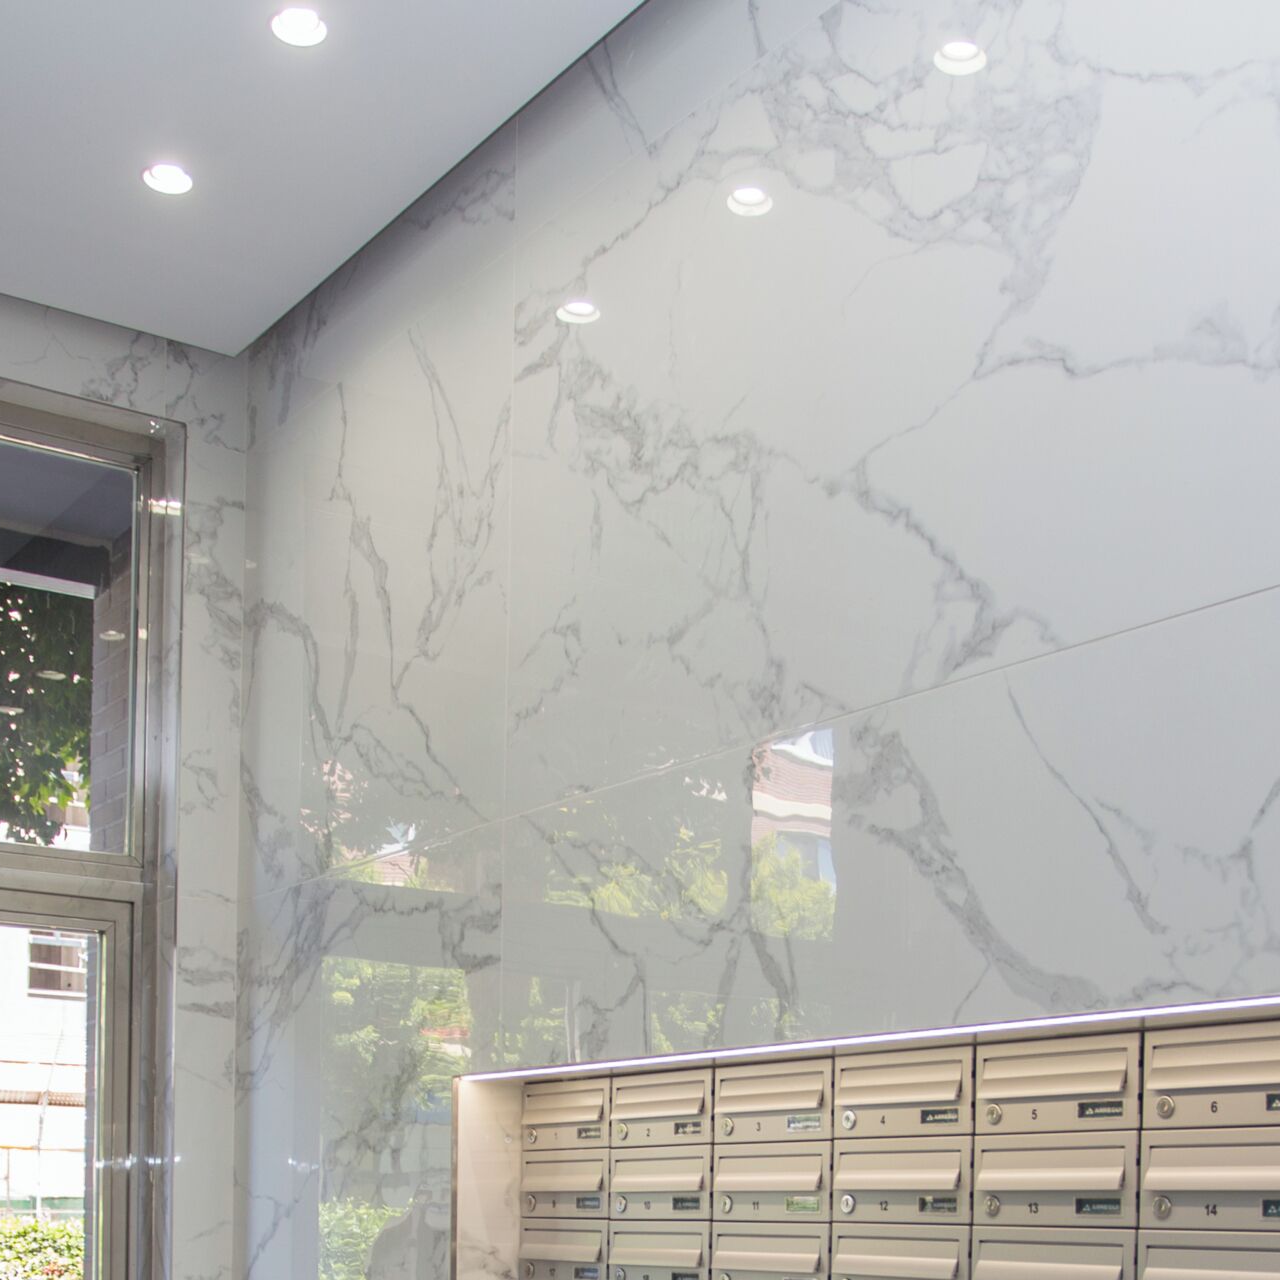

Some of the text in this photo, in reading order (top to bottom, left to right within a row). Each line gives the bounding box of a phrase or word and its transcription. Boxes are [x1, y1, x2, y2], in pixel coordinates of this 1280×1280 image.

[1210, 1100, 1218, 1114] 6
[879, 1115, 886, 1126] 4
[1031, 1108, 1038, 1121] 5
[755, 1121, 762, 1132] 3
[751, 1200, 760, 1211] 11
[879, 1199, 889, 1212] 12
[1027, 1202, 1040, 1215] 13
[1204, 1203, 1218, 1217] 14
